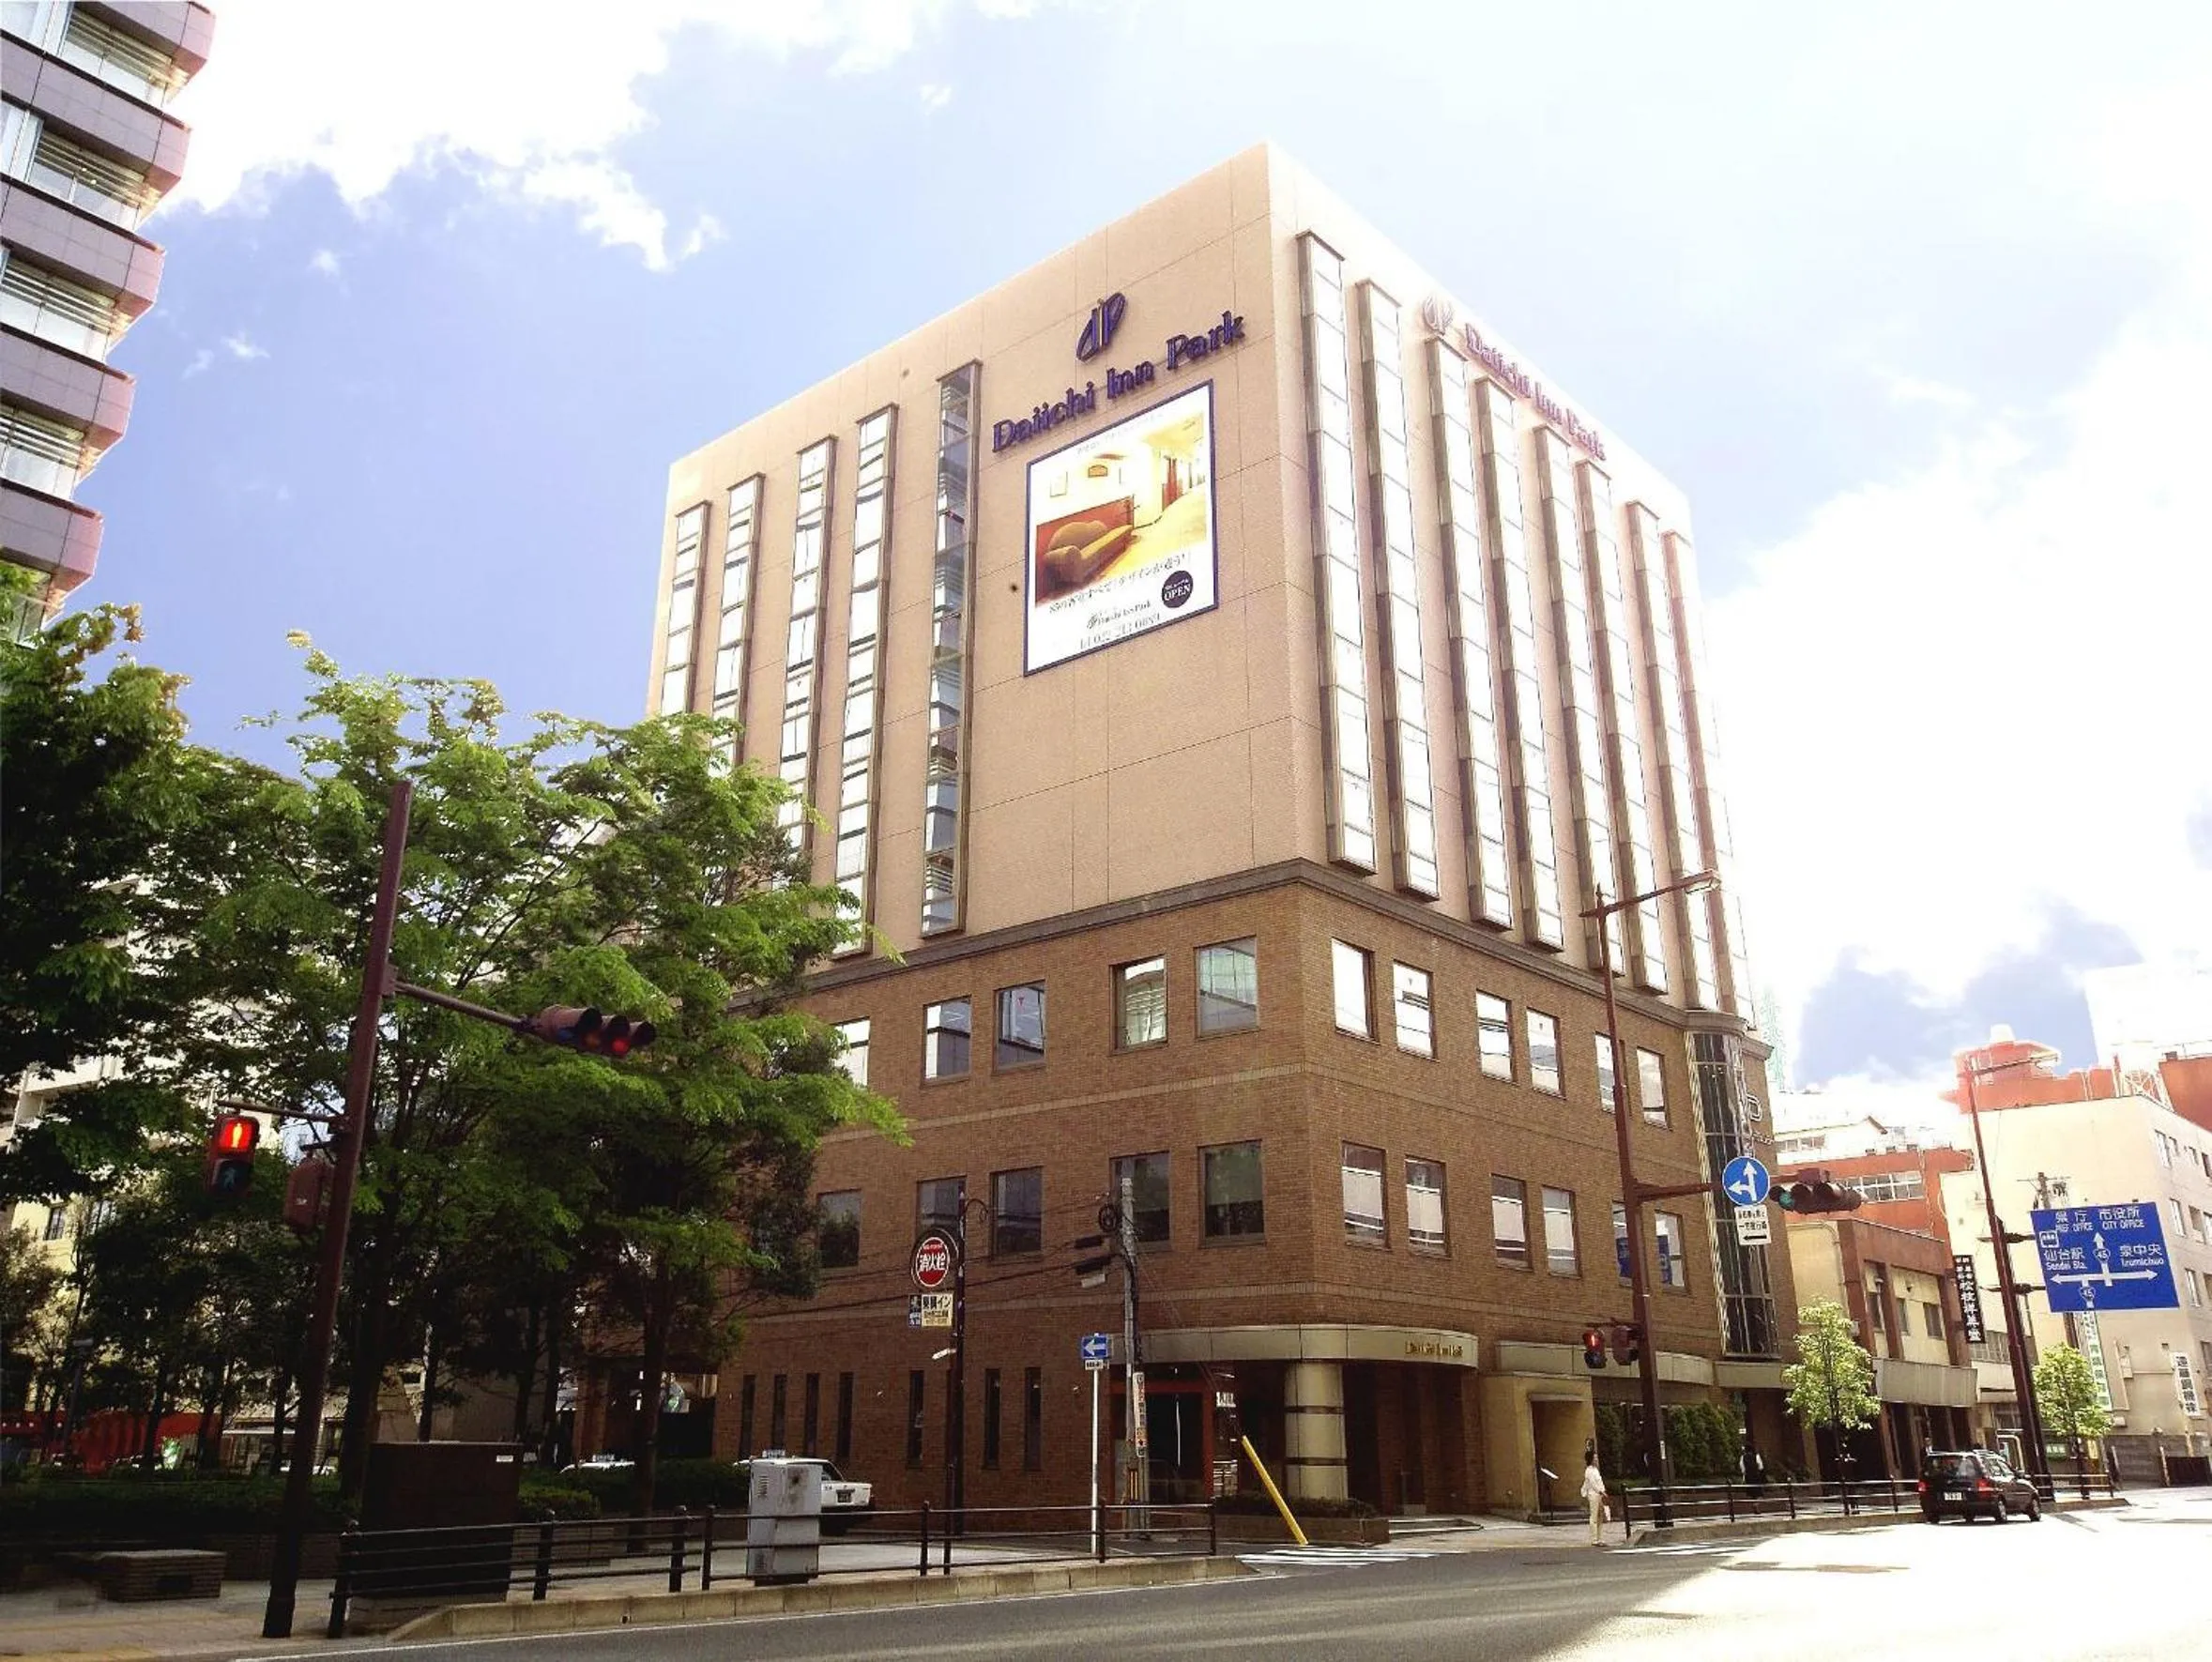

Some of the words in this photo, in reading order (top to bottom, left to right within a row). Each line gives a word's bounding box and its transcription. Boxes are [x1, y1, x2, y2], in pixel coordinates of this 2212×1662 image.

[992, 380, 1096, 452] Daiichi
[1106, 360, 1155, 400] Inn
[1166, 311, 1245, 371] Park
[1165, 583, 1191, 602] OPEN
[2101, 1220, 2118, 1230] CITY
[2044, 1247, 2085, 1262] 仙台駅
[2119, 1243, 2162, 1258] 泉中央
[920, 1252, 946, 1272] 消火栓
